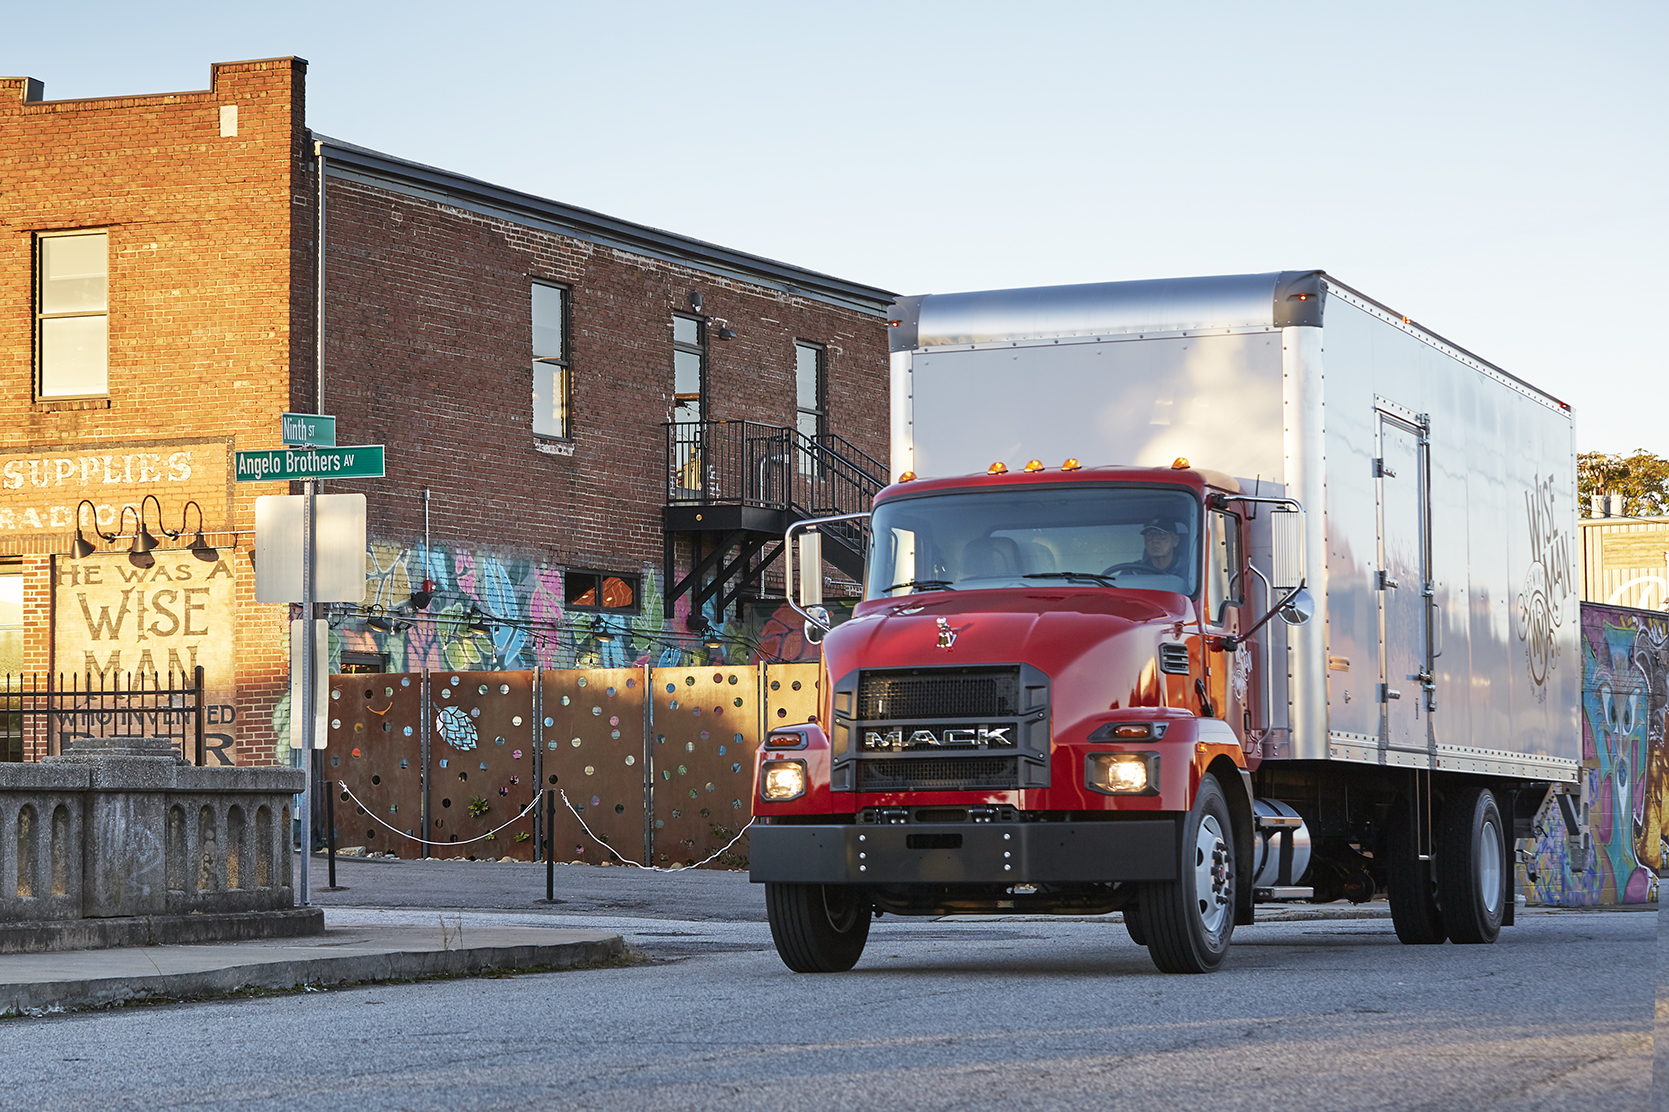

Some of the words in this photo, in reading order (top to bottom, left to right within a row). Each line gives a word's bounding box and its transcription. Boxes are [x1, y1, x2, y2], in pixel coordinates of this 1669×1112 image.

[283, 417, 307, 441] Ninth
[308, 424, 316, 437] ST
[3, 451, 193, 490] SUPPLIES
[238, 452, 281, 480] Angelo
[286, 450, 341, 473] Brothers
[343, 454, 355, 467] AV
[1524, 471, 1559, 563] WISE
[56, 564, 103, 587] HE
[115, 563, 193, 584] WAS
[204, 559, 235, 582] A
[76, 585, 211, 644] WISE
[83, 641, 201, 704] MAN
[121, 704, 236, 726] INVENED
[865, 728, 1012, 748] MACK
